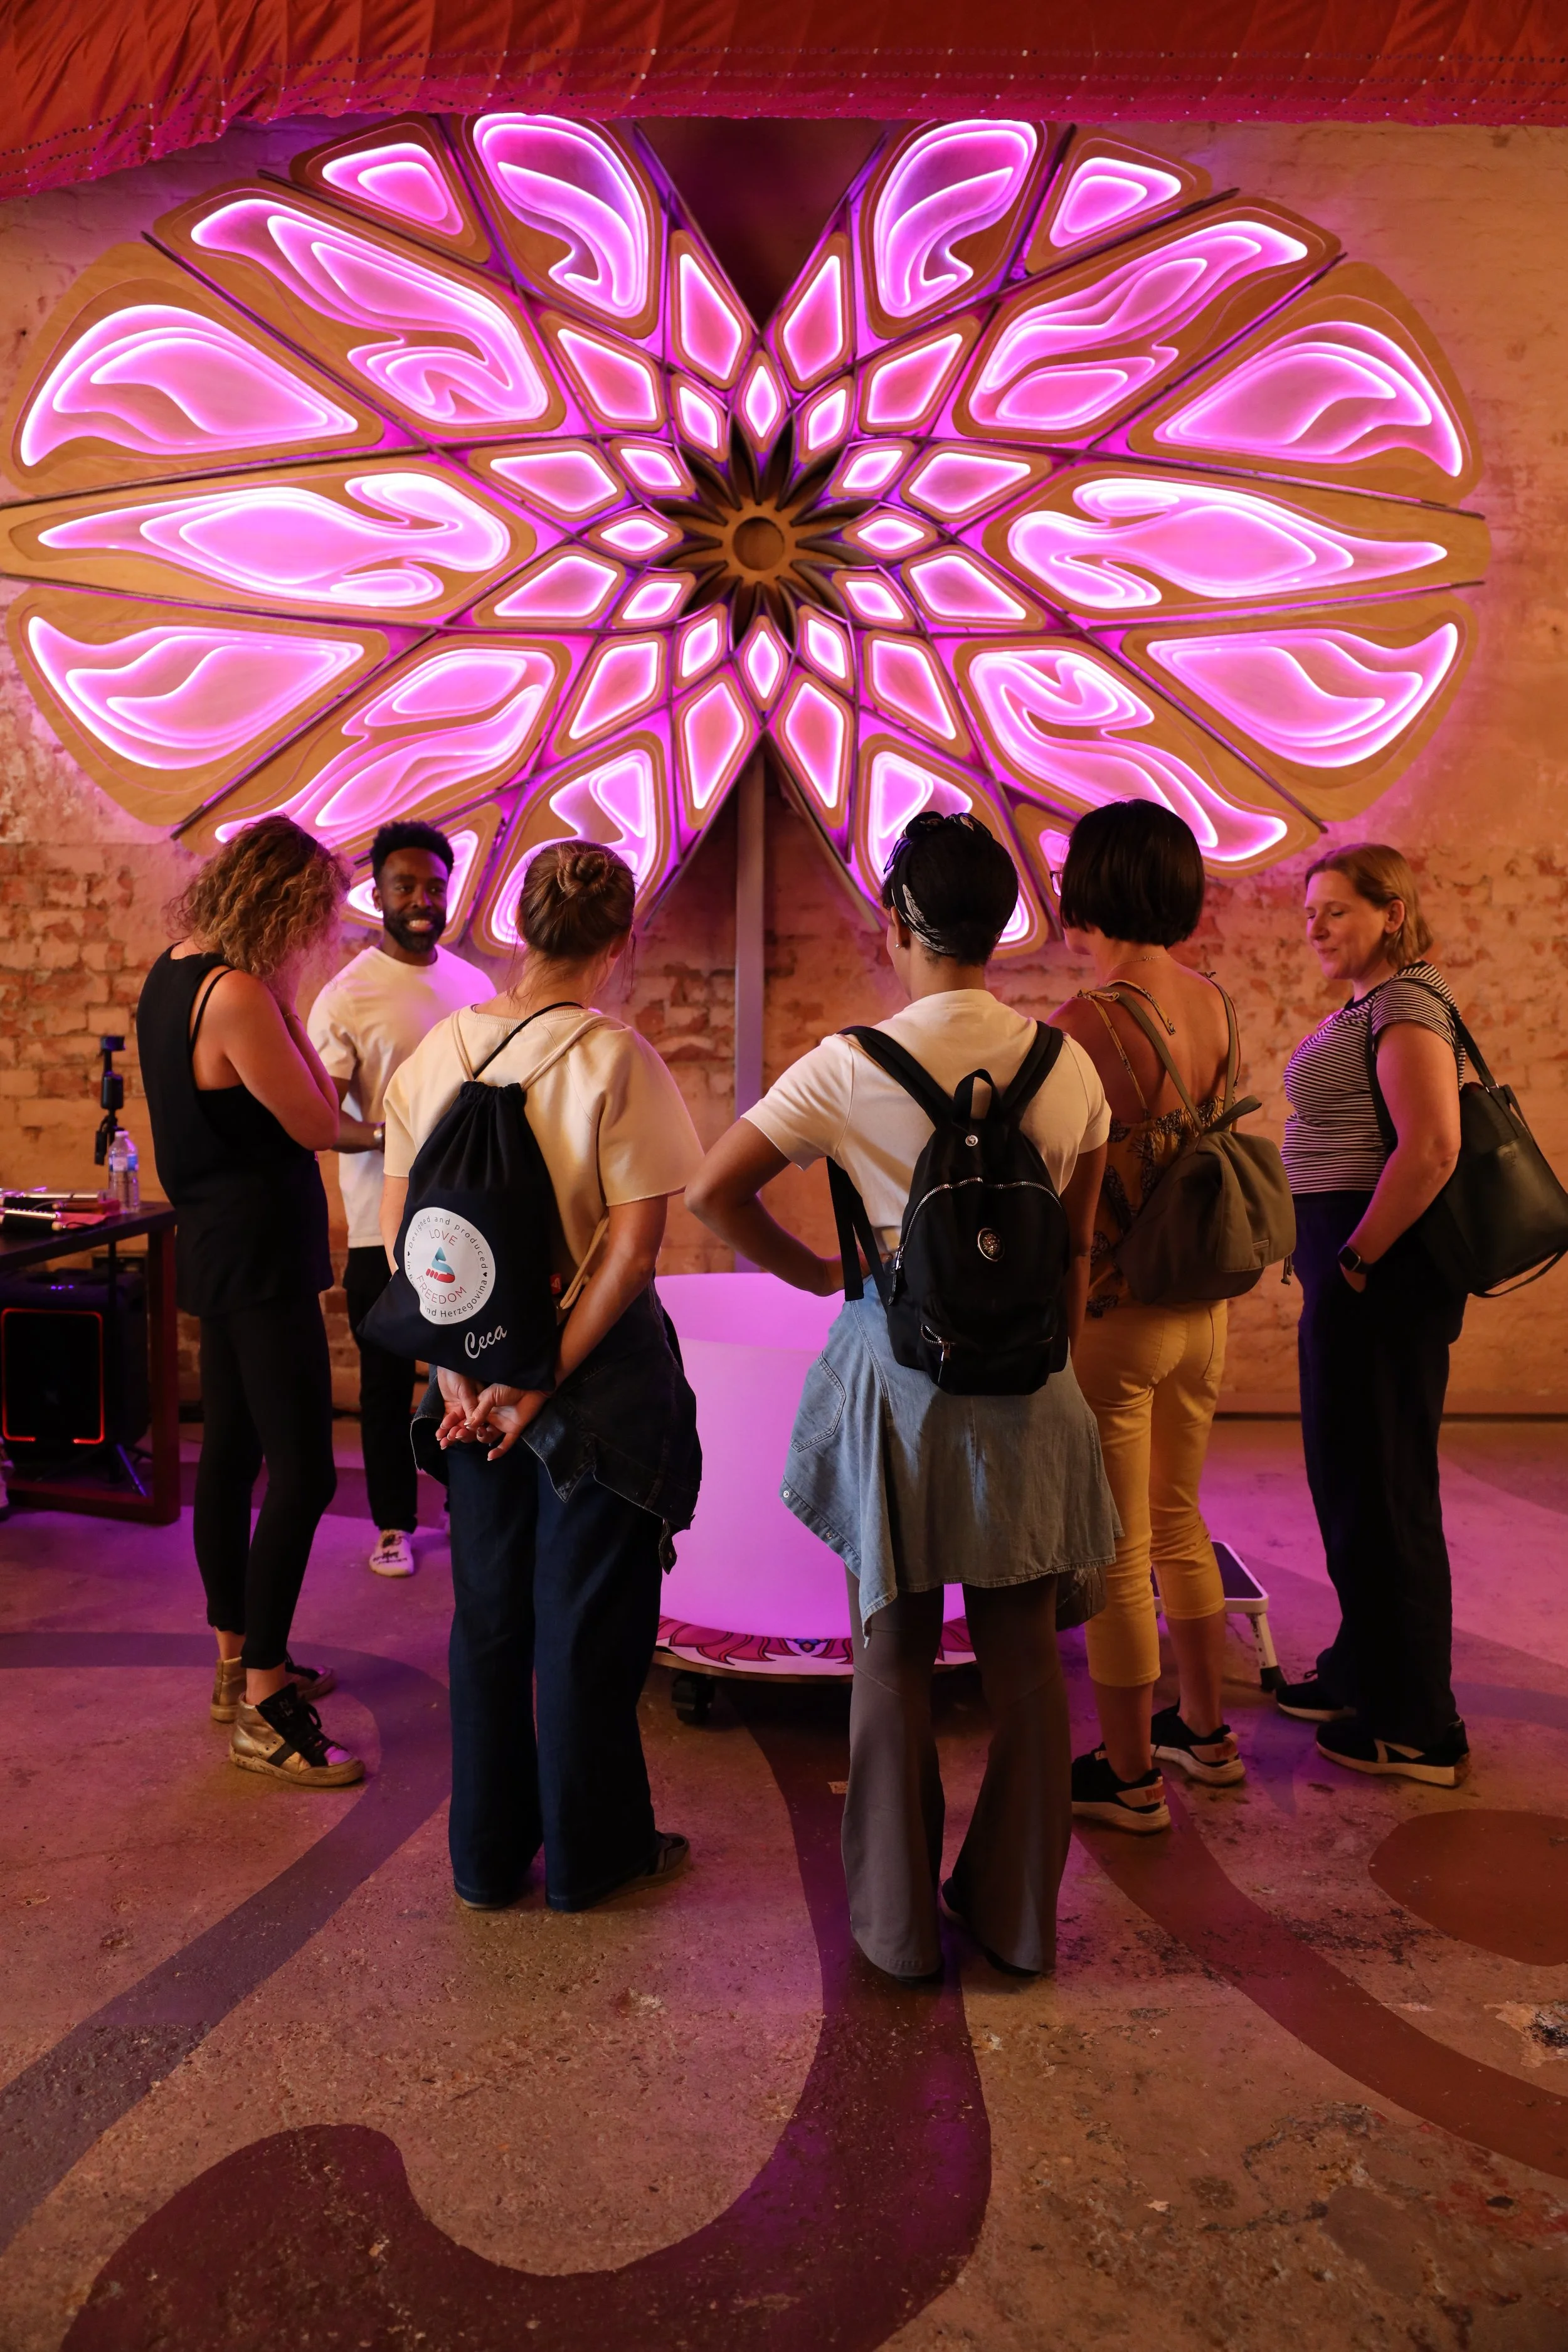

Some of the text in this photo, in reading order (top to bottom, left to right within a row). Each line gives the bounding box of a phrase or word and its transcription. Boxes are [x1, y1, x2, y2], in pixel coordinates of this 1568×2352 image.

[408, 1216, 488, 1268] Designed and produced
[429, 1229, 458, 1246] LOVE
[407, 1261, 411, 1270] in
[440, 1279, 487, 1318] Herzegovina
[416, 1275, 467, 1305] FREEDOM
[465, 1325, 507, 1359] Ceca
